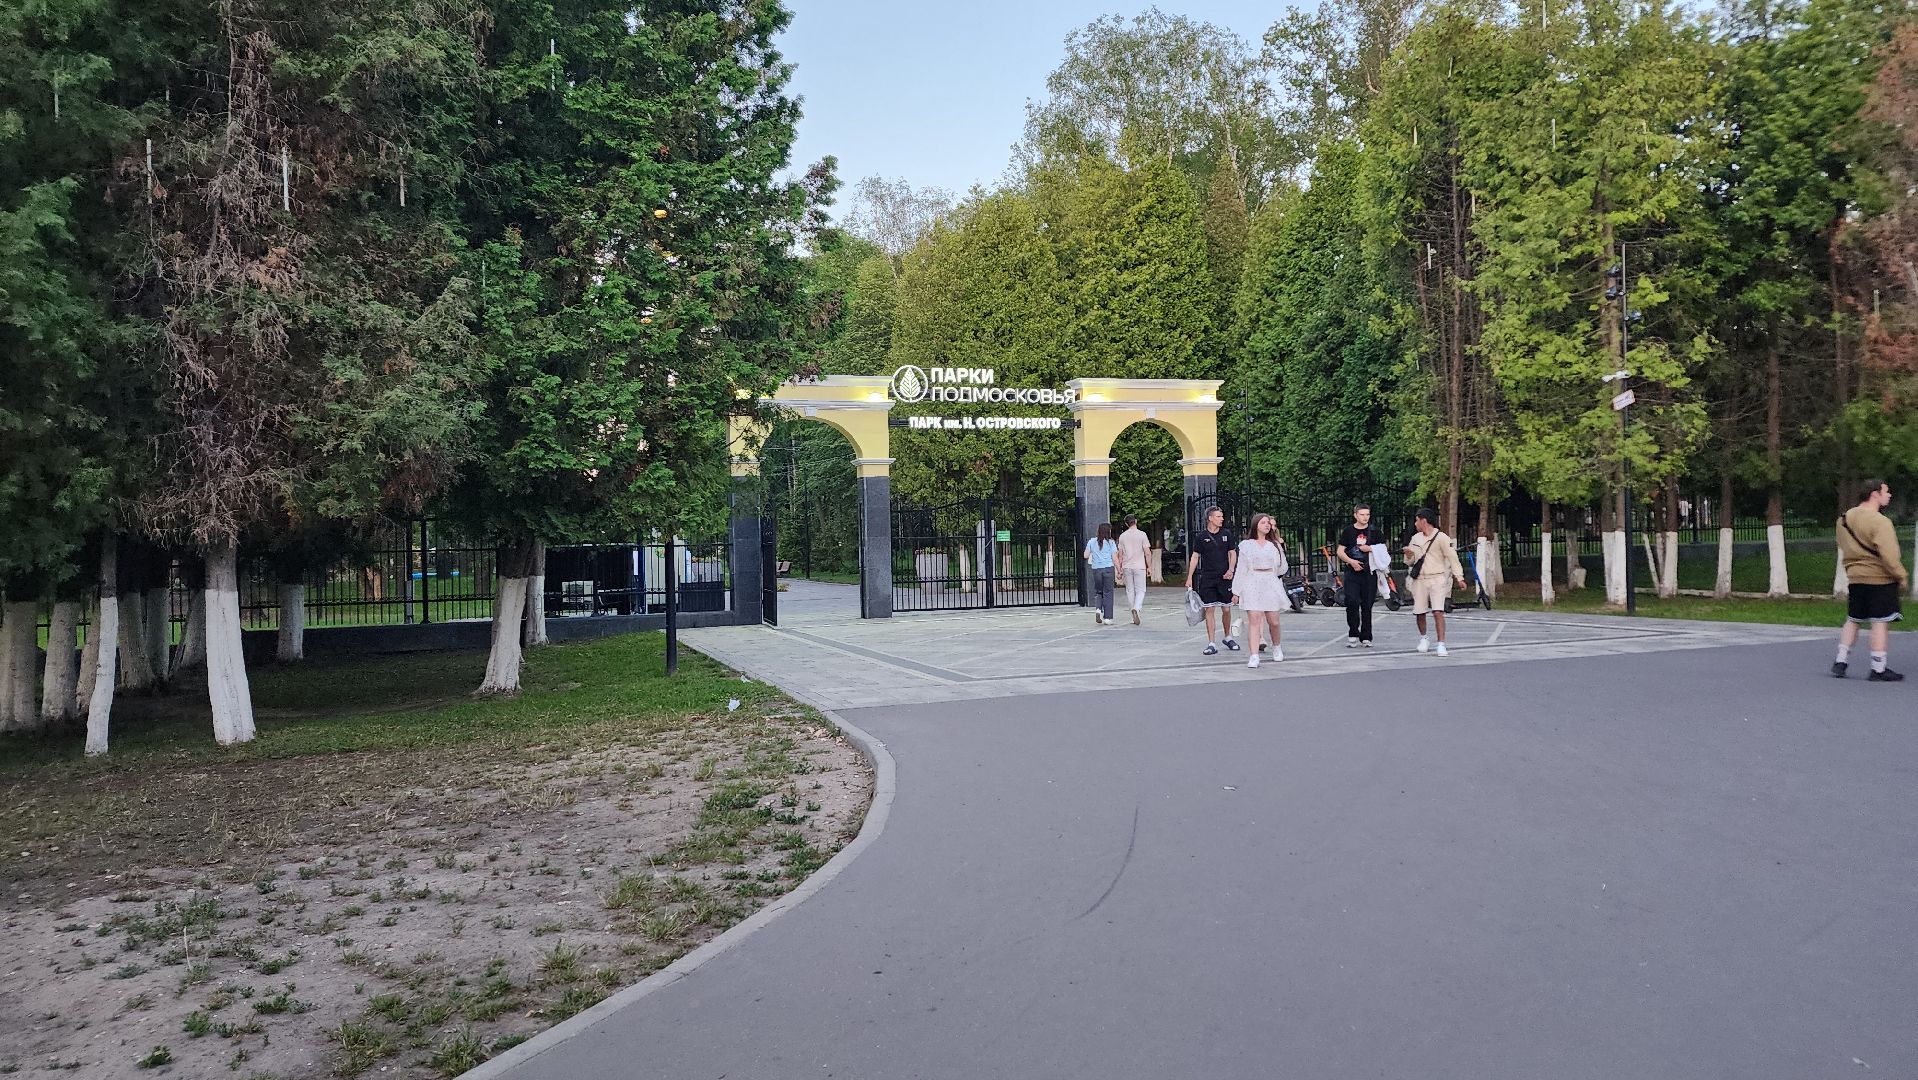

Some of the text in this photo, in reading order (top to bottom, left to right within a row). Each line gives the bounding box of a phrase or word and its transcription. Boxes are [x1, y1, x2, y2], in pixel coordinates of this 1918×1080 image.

[931, 367, 994, 384] ПАРКИ
[932, 386, 1076, 404] ПОДМОСКОВЬЯ
[909, 416, 942, 429] ПАРК
[963, 416, 975, 429] Н.
[976, 416, 1061, 429] ОСТРОВСКОГО
